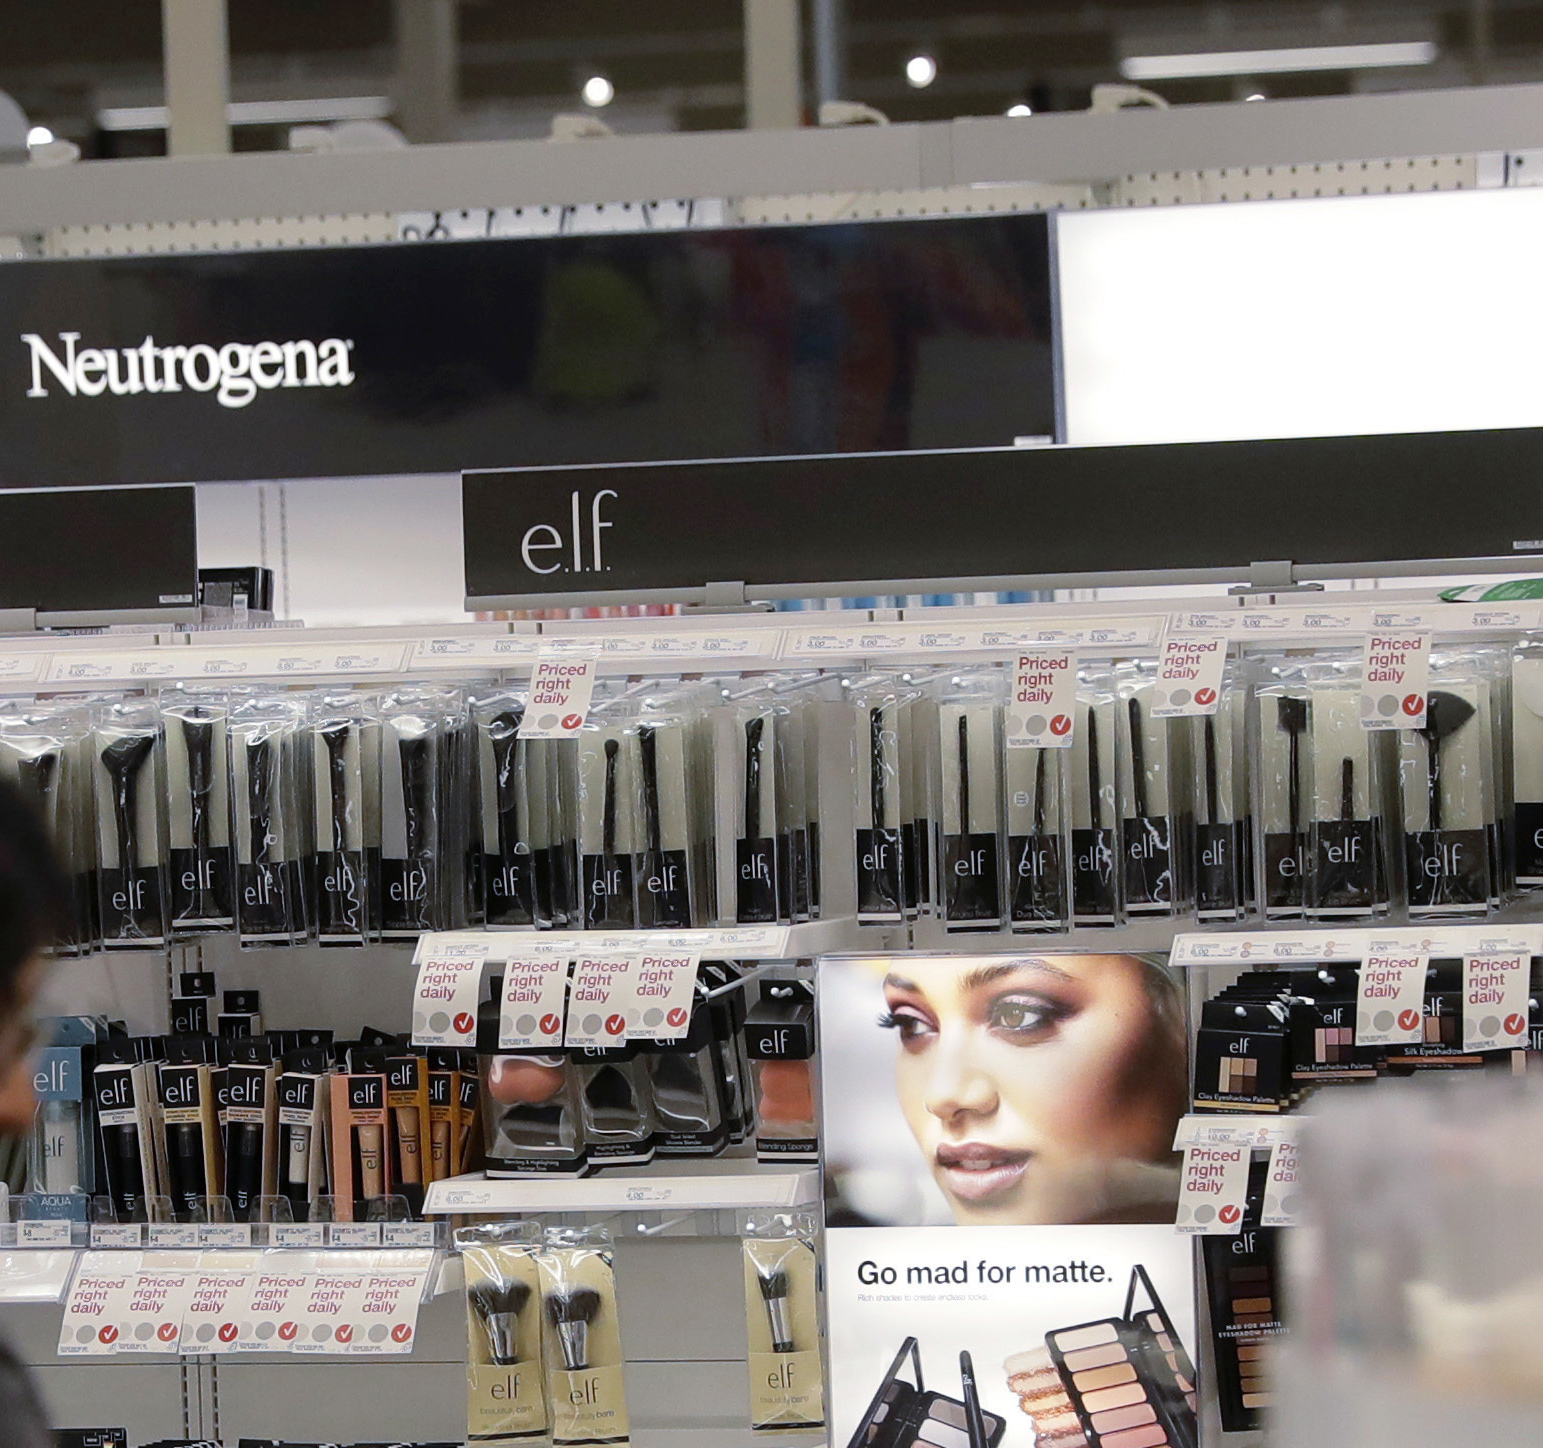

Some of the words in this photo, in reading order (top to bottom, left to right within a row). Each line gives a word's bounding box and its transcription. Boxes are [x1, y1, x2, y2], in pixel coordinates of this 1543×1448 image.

[22, 332, 354, 408] Neutrogena
[1167, 641, 1217, 653] Priced
[1370, 637, 1422, 650] Priced
[1019, 656, 1068, 669] Priced
[1164, 654, 1201, 666] right
[1369, 653, 1406, 667] right
[538, 663, 586, 676] Priced
[1162, 666, 1199, 680] daily
[1367, 669, 1404, 684] daily
[536, 677, 571, 691] right
[1018, 672, 1053, 688] right
[533, 692, 568, 705] daily
[1017, 689, 1053, 704] daily
[426, 961, 474, 972] Priced
[511, 960, 559, 972] Priced
[580, 960, 629, 972] Priced
[641, 957, 690, 968] Priced
[1368, 957, 1419, 969] Priced
[1469, 957, 1520, 972] Priced
[423, 973, 458, 985] right
[509, 974, 543, 989] right
[577, 973, 612, 988] right
[638, 969, 674, 983] right
[1365, 970, 1402, 984] right
[1469, 973, 1505, 990] right
[420, 987, 456, 1001] daily
[507, 990, 542, 1004] daily
[575, 989, 609, 1004] daily
[637, 984, 672, 998] daily
[1364, 984, 1400, 999] daily
[1468, 991, 1505, 1006] daily
[1190, 1148, 1241, 1162] Priced
[1188, 1163, 1225, 1179] right
[1186, 1180, 1224, 1195] daily
[41, 1196, 72, 1207] AQUA
[858, 1260, 897, 1285] Go
[906, 1260, 968, 1284] mad
[977, 1260, 1016, 1283] for
[1025, 1260, 1113, 1283] matte.
[78, 1278, 125, 1289] Priced
[74, 1290, 108, 1302] right
[70, 1302, 105, 1316] daily
